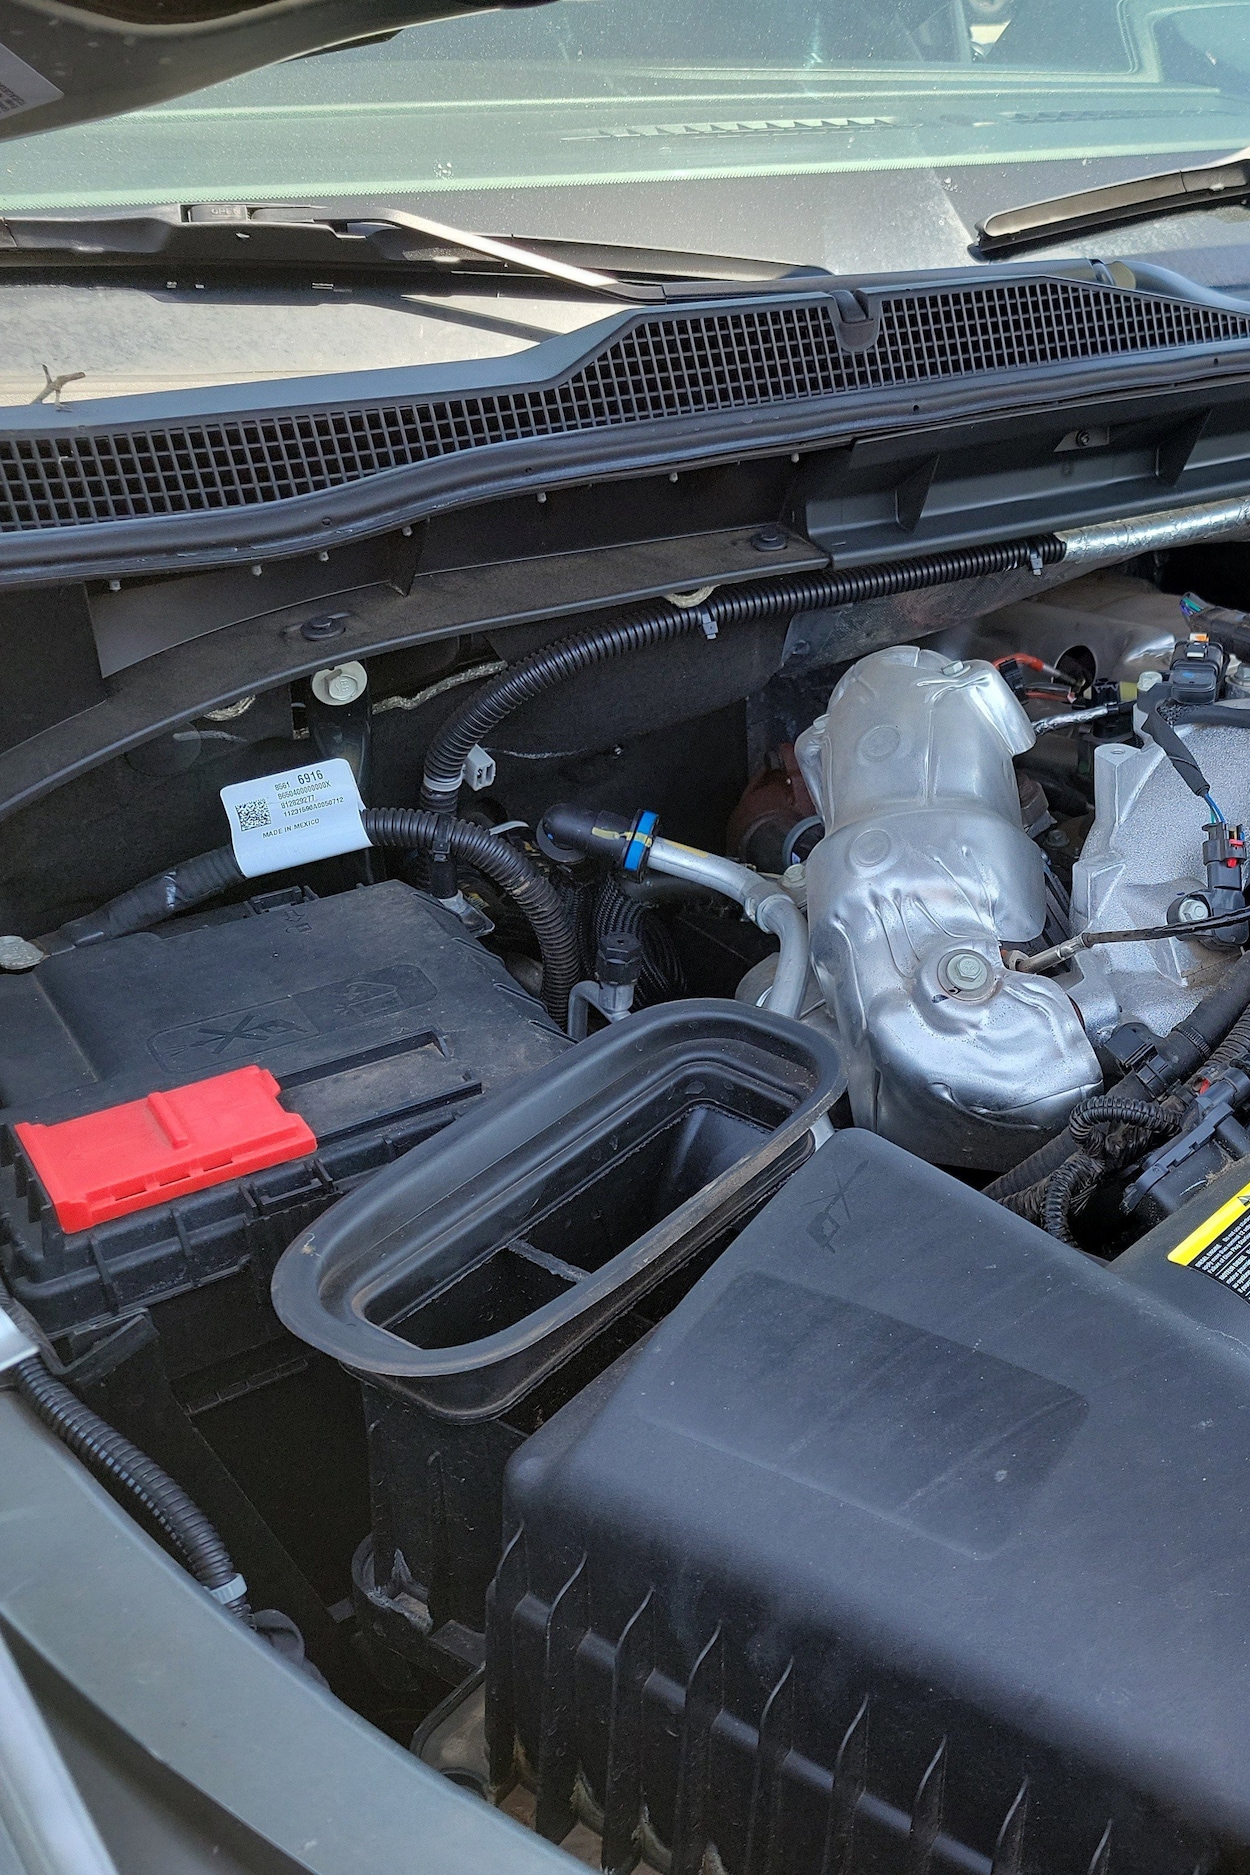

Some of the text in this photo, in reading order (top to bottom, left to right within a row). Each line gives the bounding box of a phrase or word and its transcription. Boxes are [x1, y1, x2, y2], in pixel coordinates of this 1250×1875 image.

[297, 769, 324, 785] 6916
[262, 828, 283, 838] MADE
[293, 818, 320, 830] MEXICO
